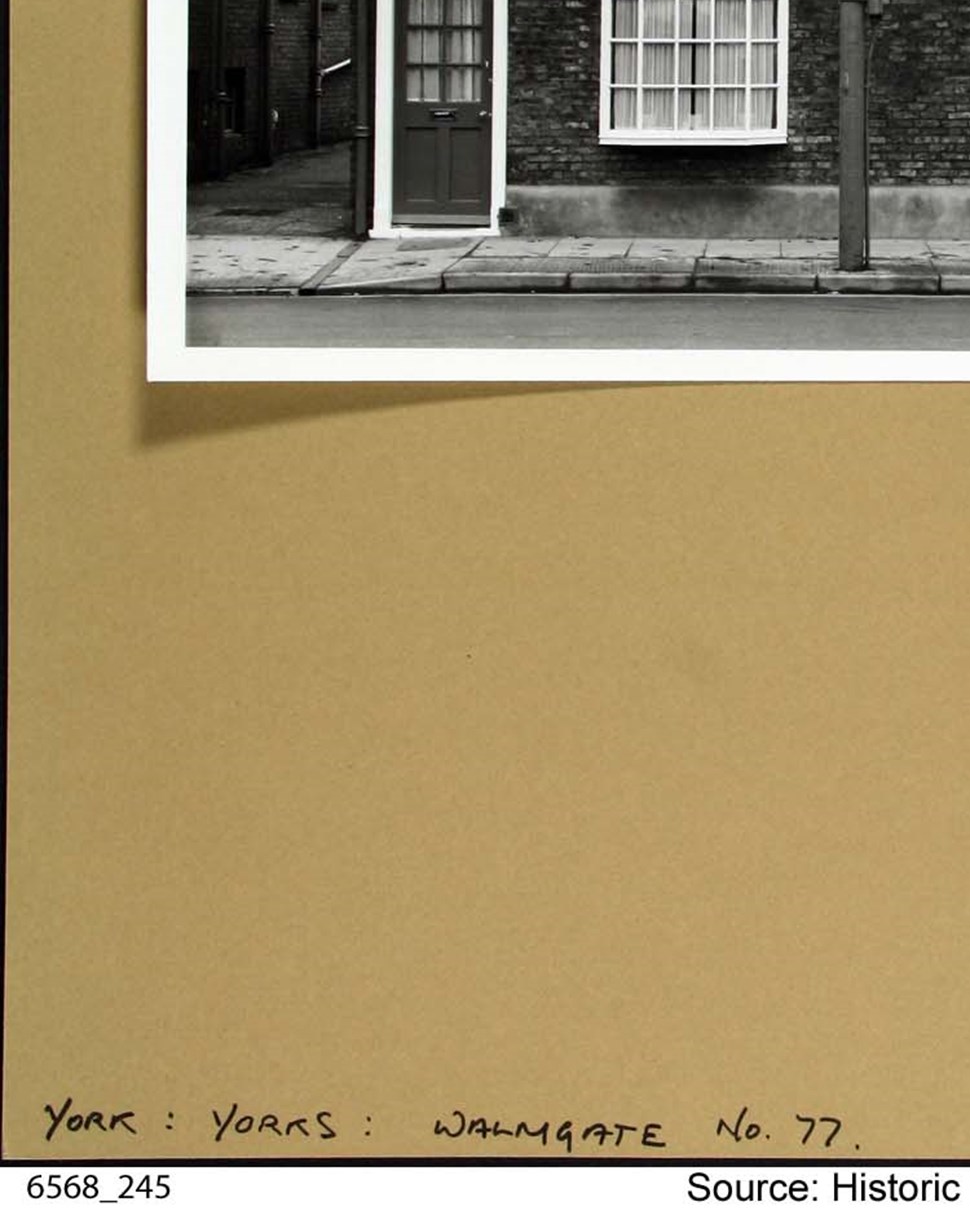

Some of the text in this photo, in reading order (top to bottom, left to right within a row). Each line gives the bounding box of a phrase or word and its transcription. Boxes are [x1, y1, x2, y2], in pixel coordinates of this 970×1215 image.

[44, 1097, 137, 1142] YORK
[211, 1103, 337, 1142] YORKS
[432, 1110, 667, 1153] WALMGATE
[715, 1106, 771, 1143] No.
